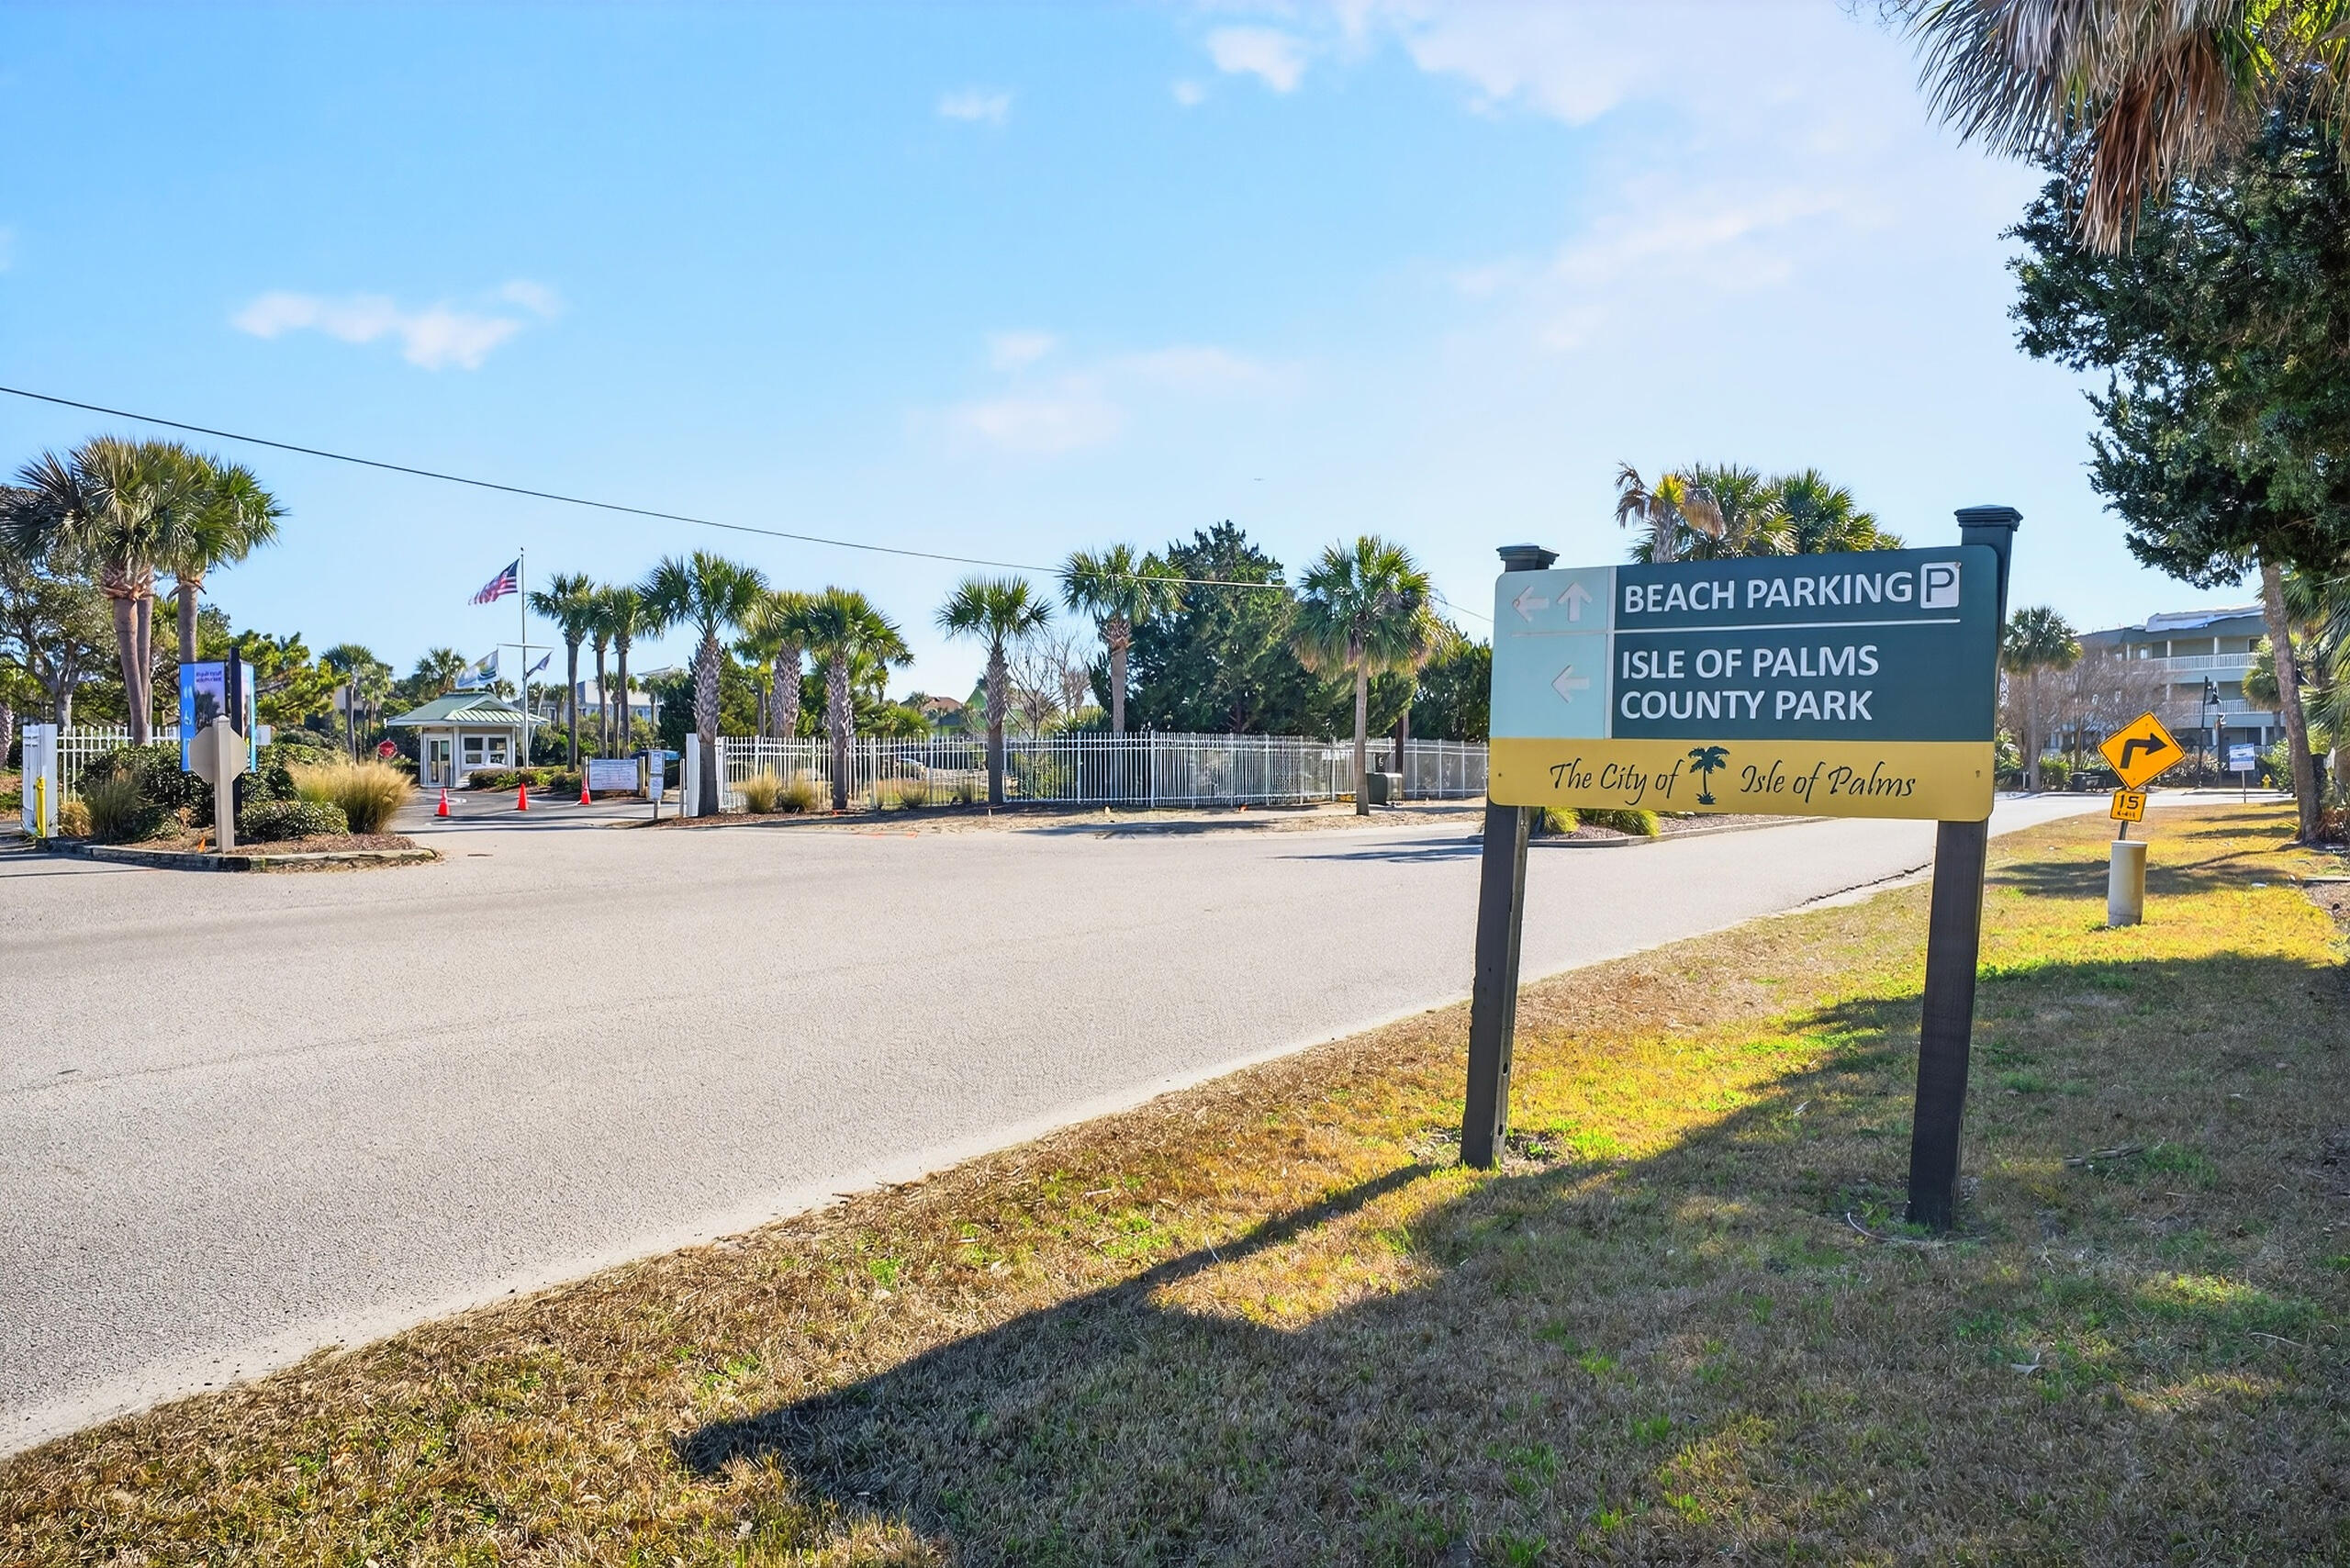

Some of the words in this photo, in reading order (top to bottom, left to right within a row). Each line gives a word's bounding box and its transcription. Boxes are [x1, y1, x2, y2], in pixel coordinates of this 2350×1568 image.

[1625, 579, 1735, 613] BEACH
[1747, 571, 1913, 609] PARKING
[1926, 567, 1955, 603] P
[1622, 650, 1685, 679] ISLE
[1695, 648, 1742, 678] OF
[1752, 644, 1879, 678] PALMS
[1620, 689, 1765, 720] COUNTY
[1775, 689, 1874, 721] PARK
[1550, 757, 1593, 790] The
[1601, 763, 1648, 806] City
[1655, 758, 1685, 800] of
[1740, 759, 1785, 794] Isle
[1793, 761, 1826, 802] of
[1827, 760, 1916, 798] Palms
[2120, 794, 2139, 810] 15
